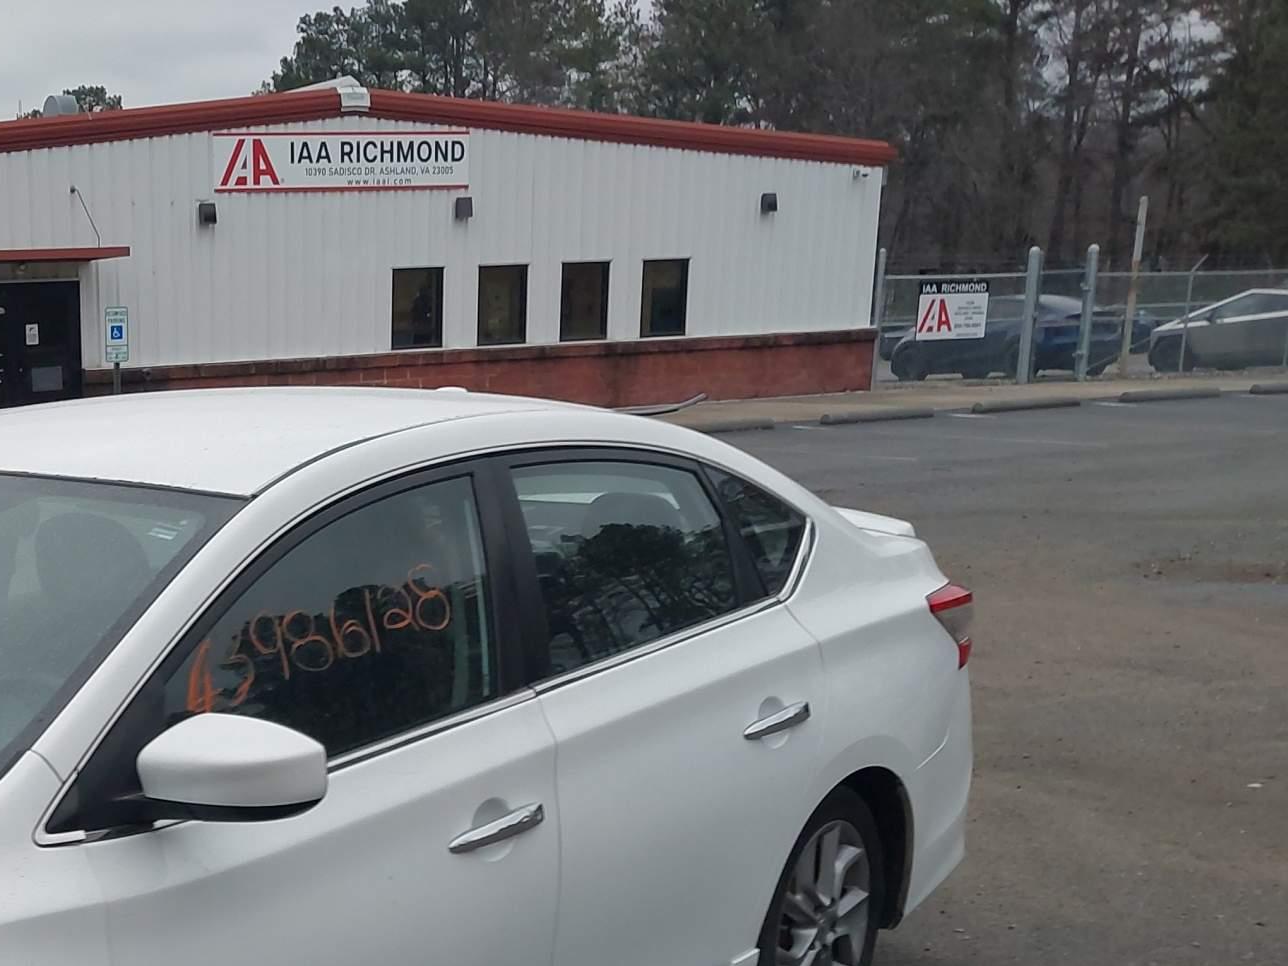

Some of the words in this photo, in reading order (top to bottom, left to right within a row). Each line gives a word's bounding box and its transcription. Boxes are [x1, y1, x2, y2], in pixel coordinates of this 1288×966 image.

[289, 141, 332, 164] IAA
[339, 140, 466, 163] RICHMOND
[305, 167, 326, 176] 10390
[328, 167, 362, 176] SADISCO
[420, 166, 430, 175] VA
[432, 166, 454, 175] 23005
[922, 283, 938, 293] IAA
[941, 282, 987, 293] RICHMOND
